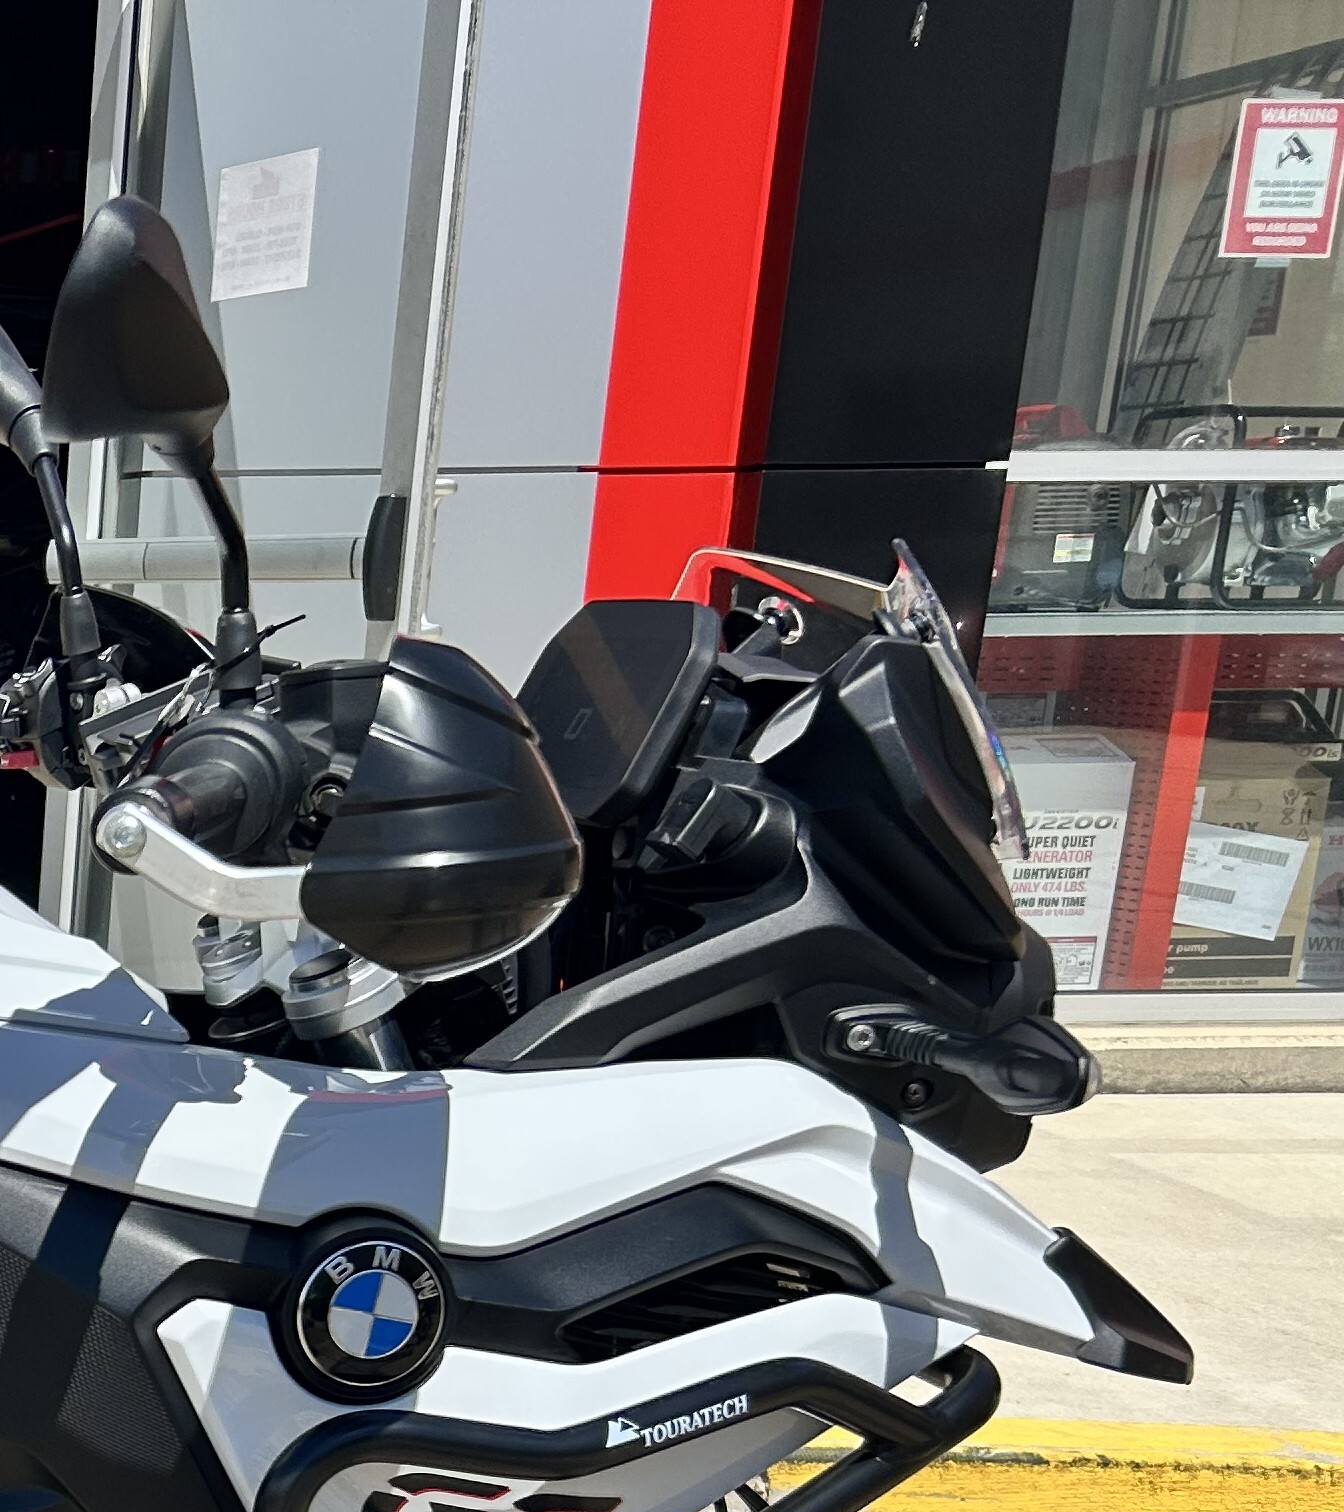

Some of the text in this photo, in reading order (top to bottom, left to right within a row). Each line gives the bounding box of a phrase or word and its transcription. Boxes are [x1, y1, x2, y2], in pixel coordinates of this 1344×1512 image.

[1261, 107, 1338, 123] WARNING
[1025, 815, 1120, 830] U2200i
[1027, 836, 1097, 849] UPER QUIET
[1012, 867, 1092, 880] LIGHTWEIGHT
[1012, 882, 1041, 894] ONLY
[1037, 897, 1059, 908] RUN
[1061, 897, 1087, 907] TIME
[1176, 942, 1209, 954] pump
[326, 1245, 440, 1301] BMW
[642, 1394, 749, 1449] TOURATECH
